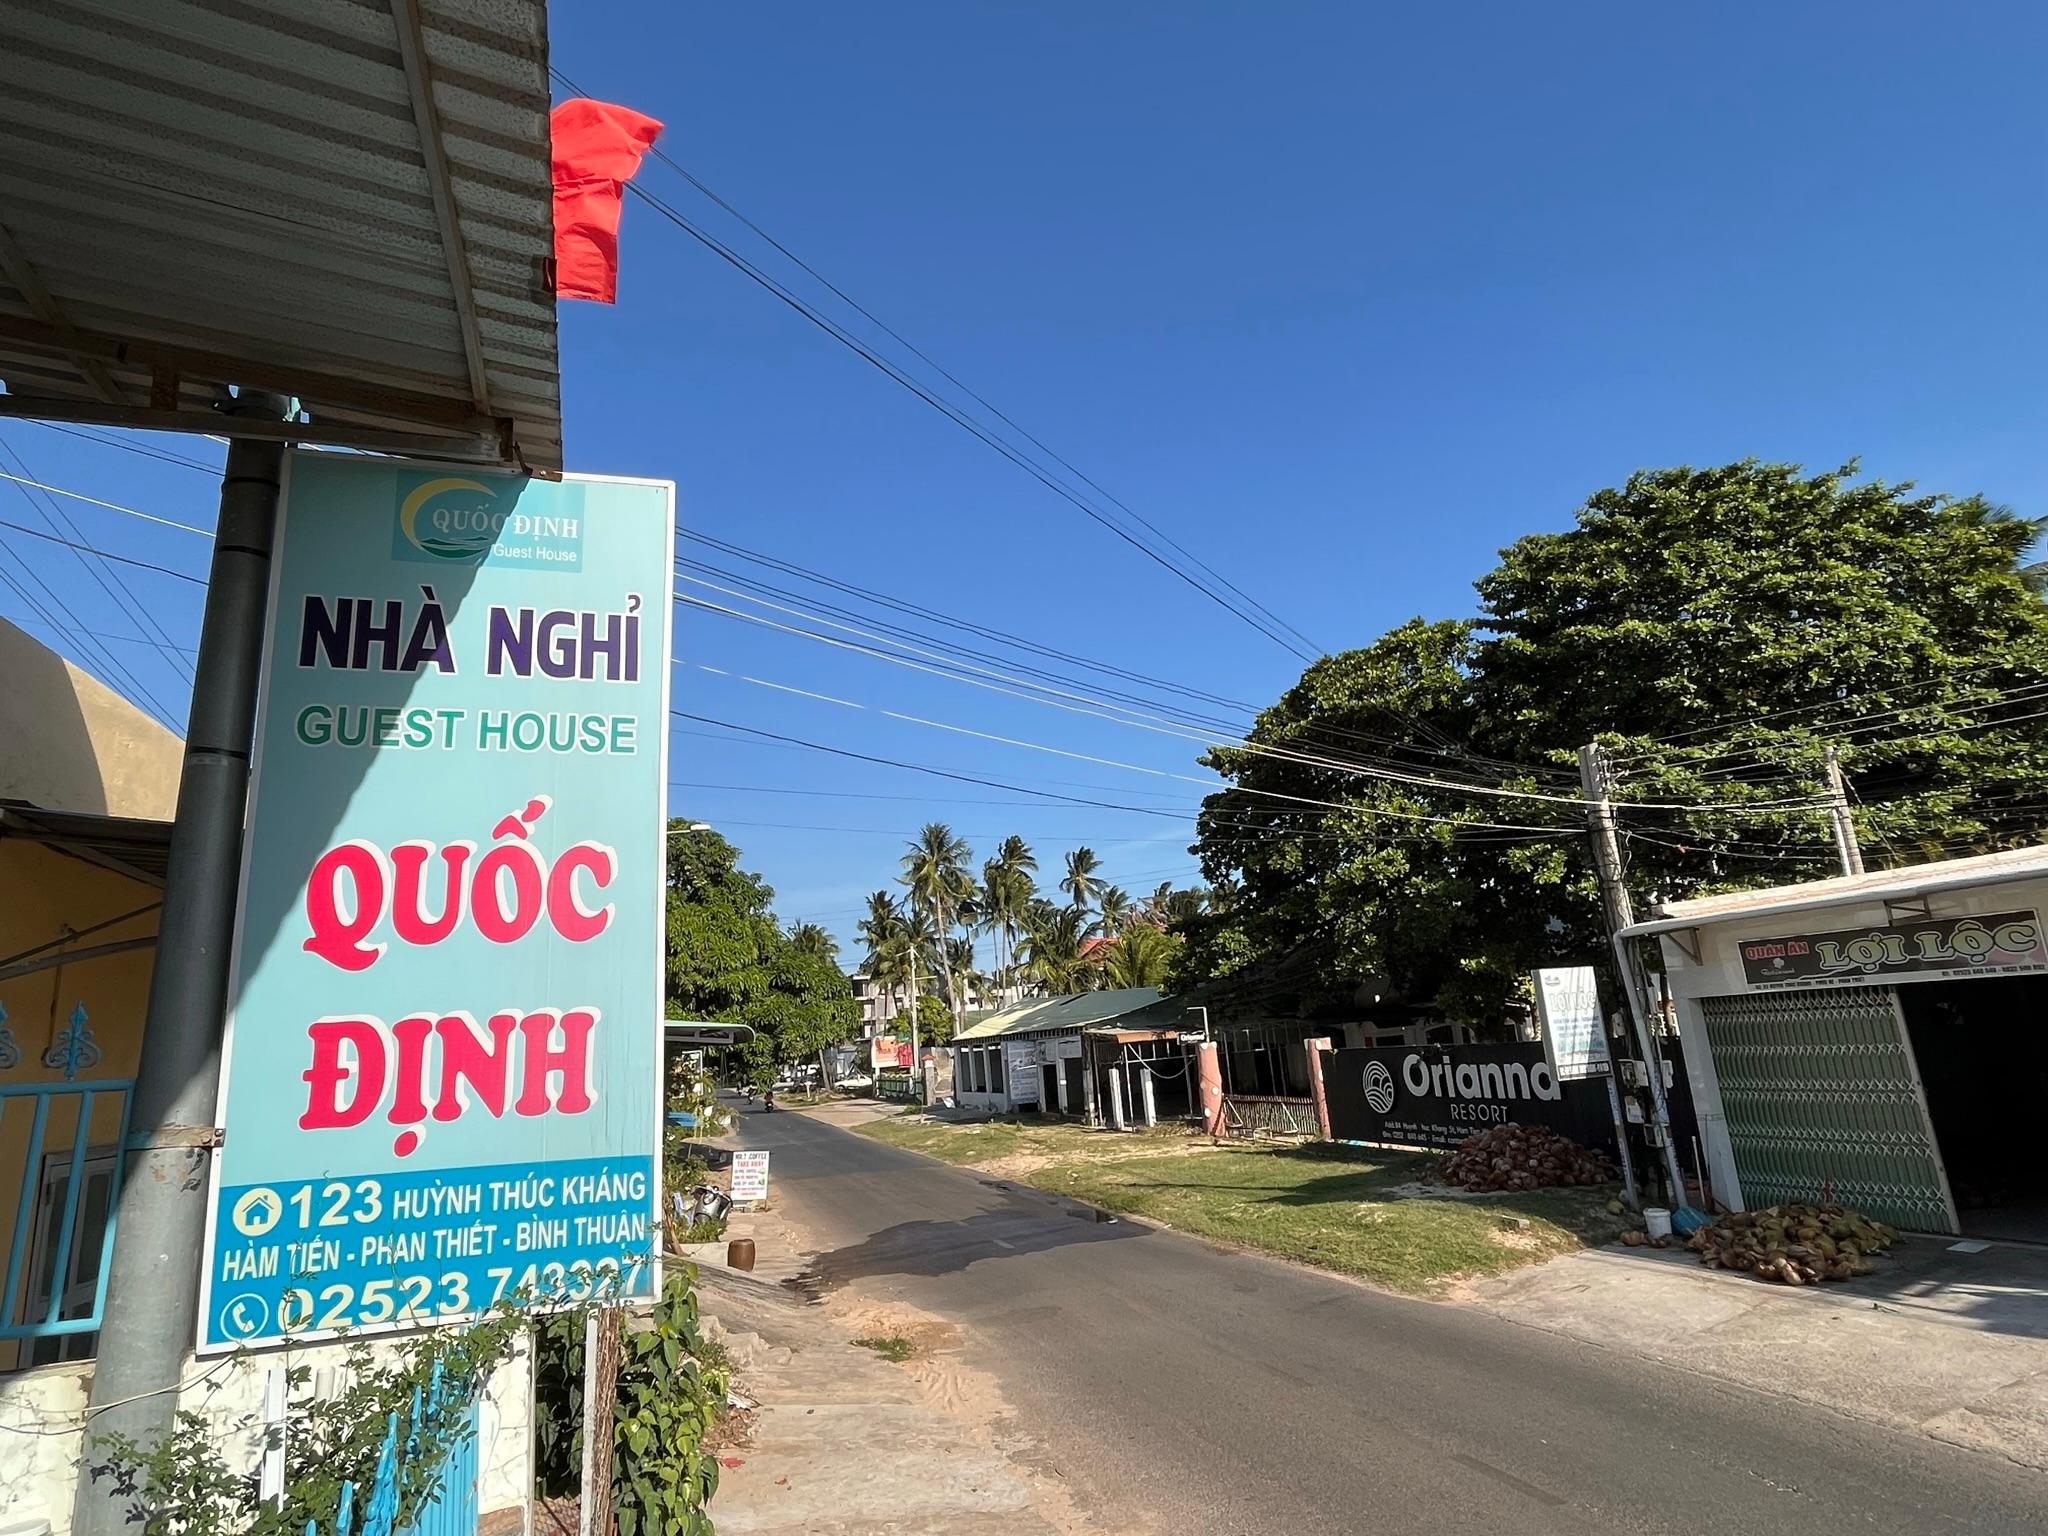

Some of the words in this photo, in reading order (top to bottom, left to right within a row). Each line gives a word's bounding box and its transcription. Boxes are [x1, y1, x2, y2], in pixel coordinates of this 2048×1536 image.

[494, 543, 533, 559] Guest
[536, 546, 577, 562] House
[513, 514, 579, 541] ĐỊNH
[298, 585, 457, 675] NHÀ
[485, 593, 642, 683] NGHỈ
[297, 705, 466, 752] GUEST
[478, 709, 638, 755] HOUSE
[302, 794, 618, 972] QUỐC
[1816, 931, 1906, 973] LỢI
[1914, 919, 2038, 965] LỘC
[298, 1005, 601, 1158] ĐỊNH
[1402, 1053, 1562, 1101] Orianna
[1449, 1103, 1508, 1124] RESORT
[289, 1179, 383, 1229] 123
[393, 1179, 481, 1221] HUỲNH
[490, 1168, 555, 1212] THÚC
[562, 1165, 646, 1207] KHÁNG
[222, 1237, 280, 1282] HÀM
[286, 1233, 340, 1273] TIẾN
[361, 1230, 425, 1268] PHAN
[433, 1222, 498, 1260] THIẾT
[516, 1214, 568, 1253] BÌNH
[575, 1210, 646, 1248] THUẬN
[277, 1270, 467, 1333] 02523
